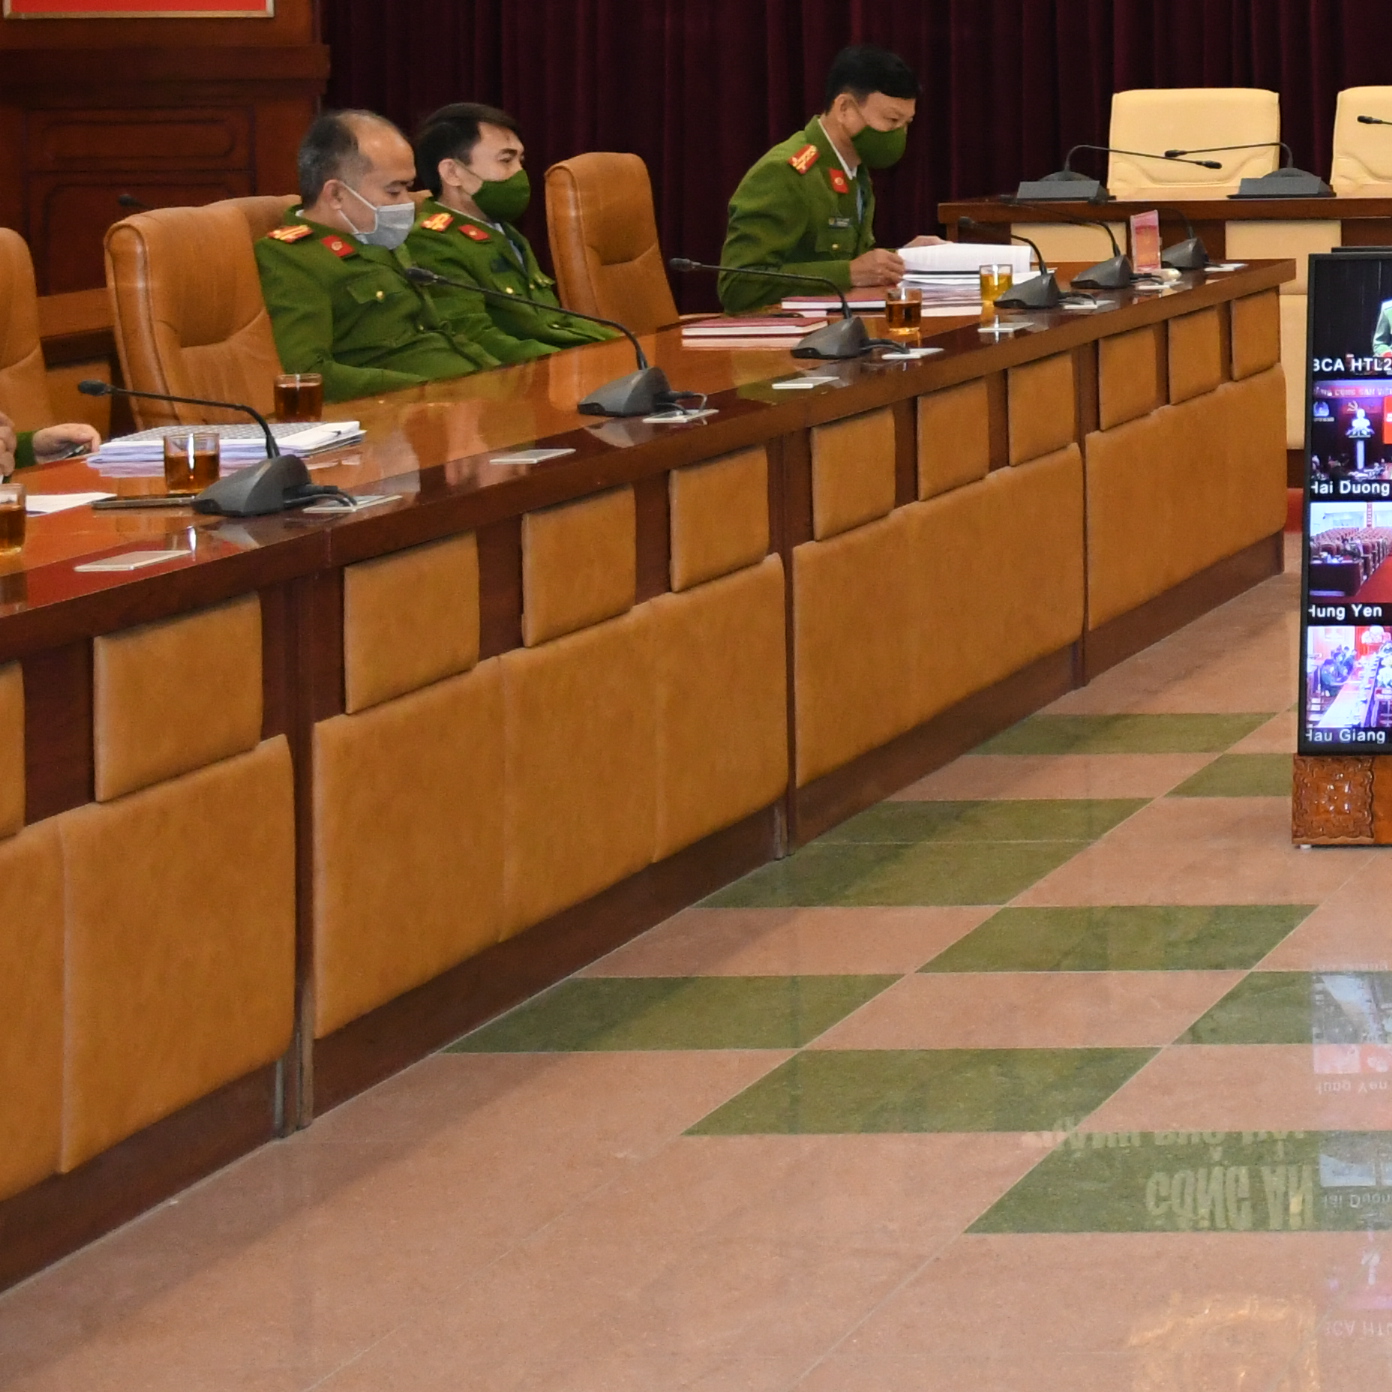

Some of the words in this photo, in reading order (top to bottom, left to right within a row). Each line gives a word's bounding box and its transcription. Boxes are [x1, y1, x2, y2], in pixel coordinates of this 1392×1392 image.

[1351, 357, 1392, 372] HTL2
[1340, 480, 1390, 497] Duong
[1352, 604, 1383, 617] Yen
[1337, 728, 1385, 745] Giang
